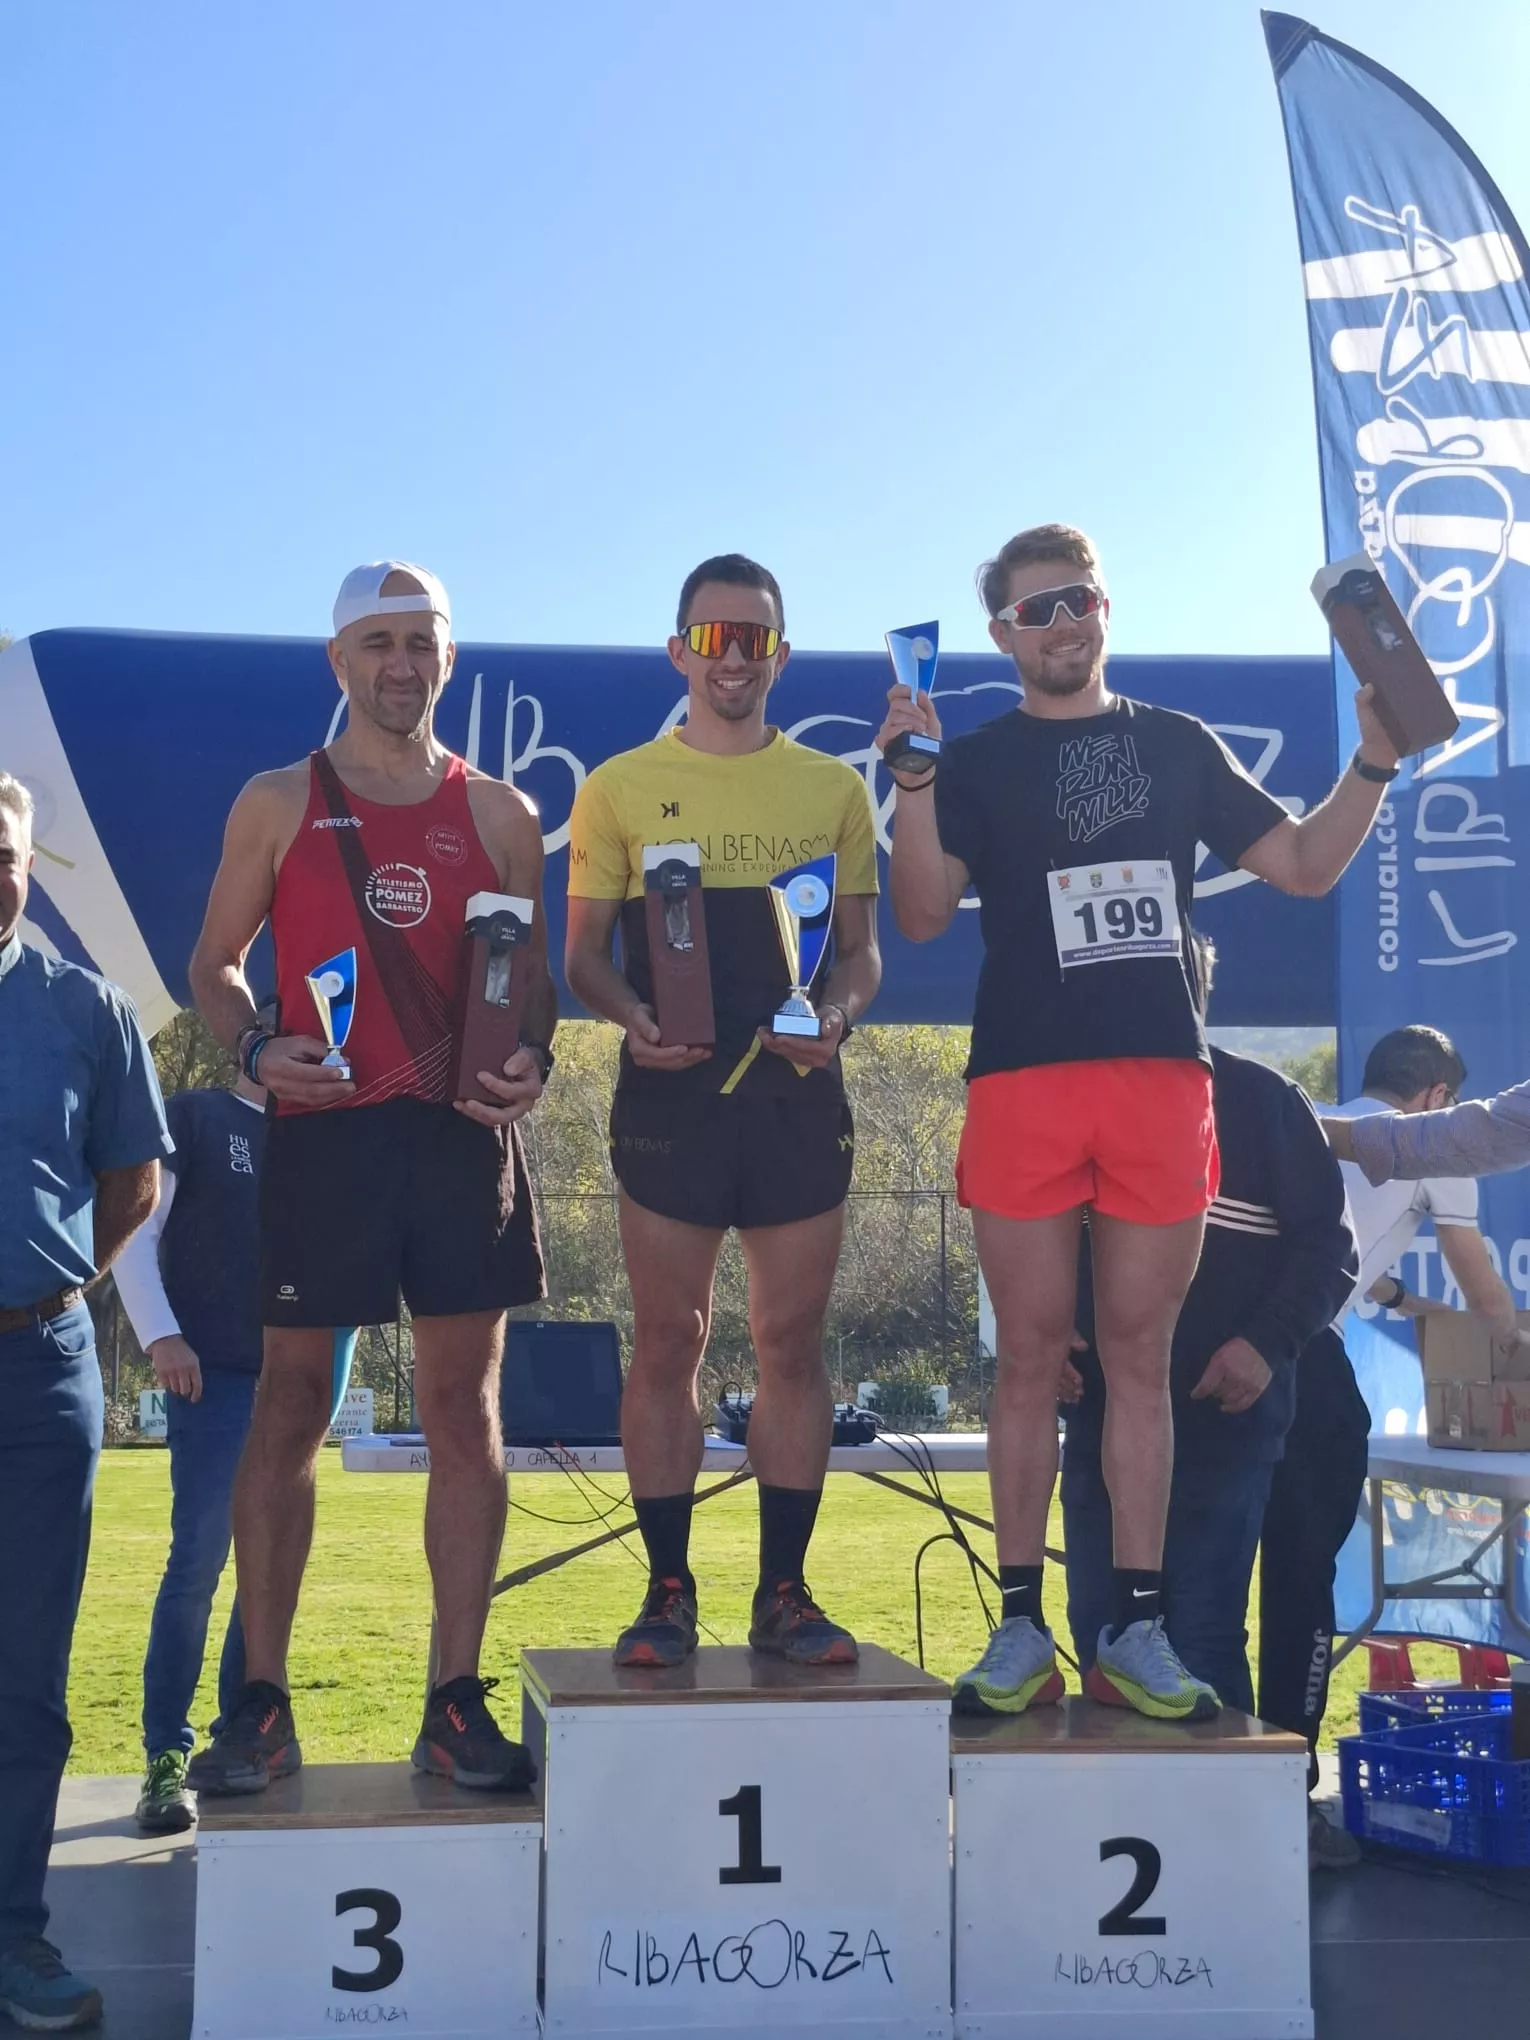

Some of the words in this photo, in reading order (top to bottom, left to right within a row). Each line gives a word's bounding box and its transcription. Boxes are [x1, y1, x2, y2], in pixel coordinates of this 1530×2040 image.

[1059, 735, 1118, 773] WE
[1056, 735, 1141, 819] RUN
[375, 887, 423, 903] PÓMEZ
[376, 878, 423, 889] ATLETISMO
[376, 902, 423, 914] BARBASTRO
[1073, 896, 1163, 944] 199
[528, 1452, 580, 1465] CAPELLA
[589, 1452, 597, 1464] 1
[719, 1785, 782, 1884] 1
[1098, 1836, 1167, 1936] 2
[332, 1888, 404, 1993] 3
[598, 1919, 894, 1988] RIBAGORZA
[1054, 1950, 1213, 1989] RIBAGORZA
